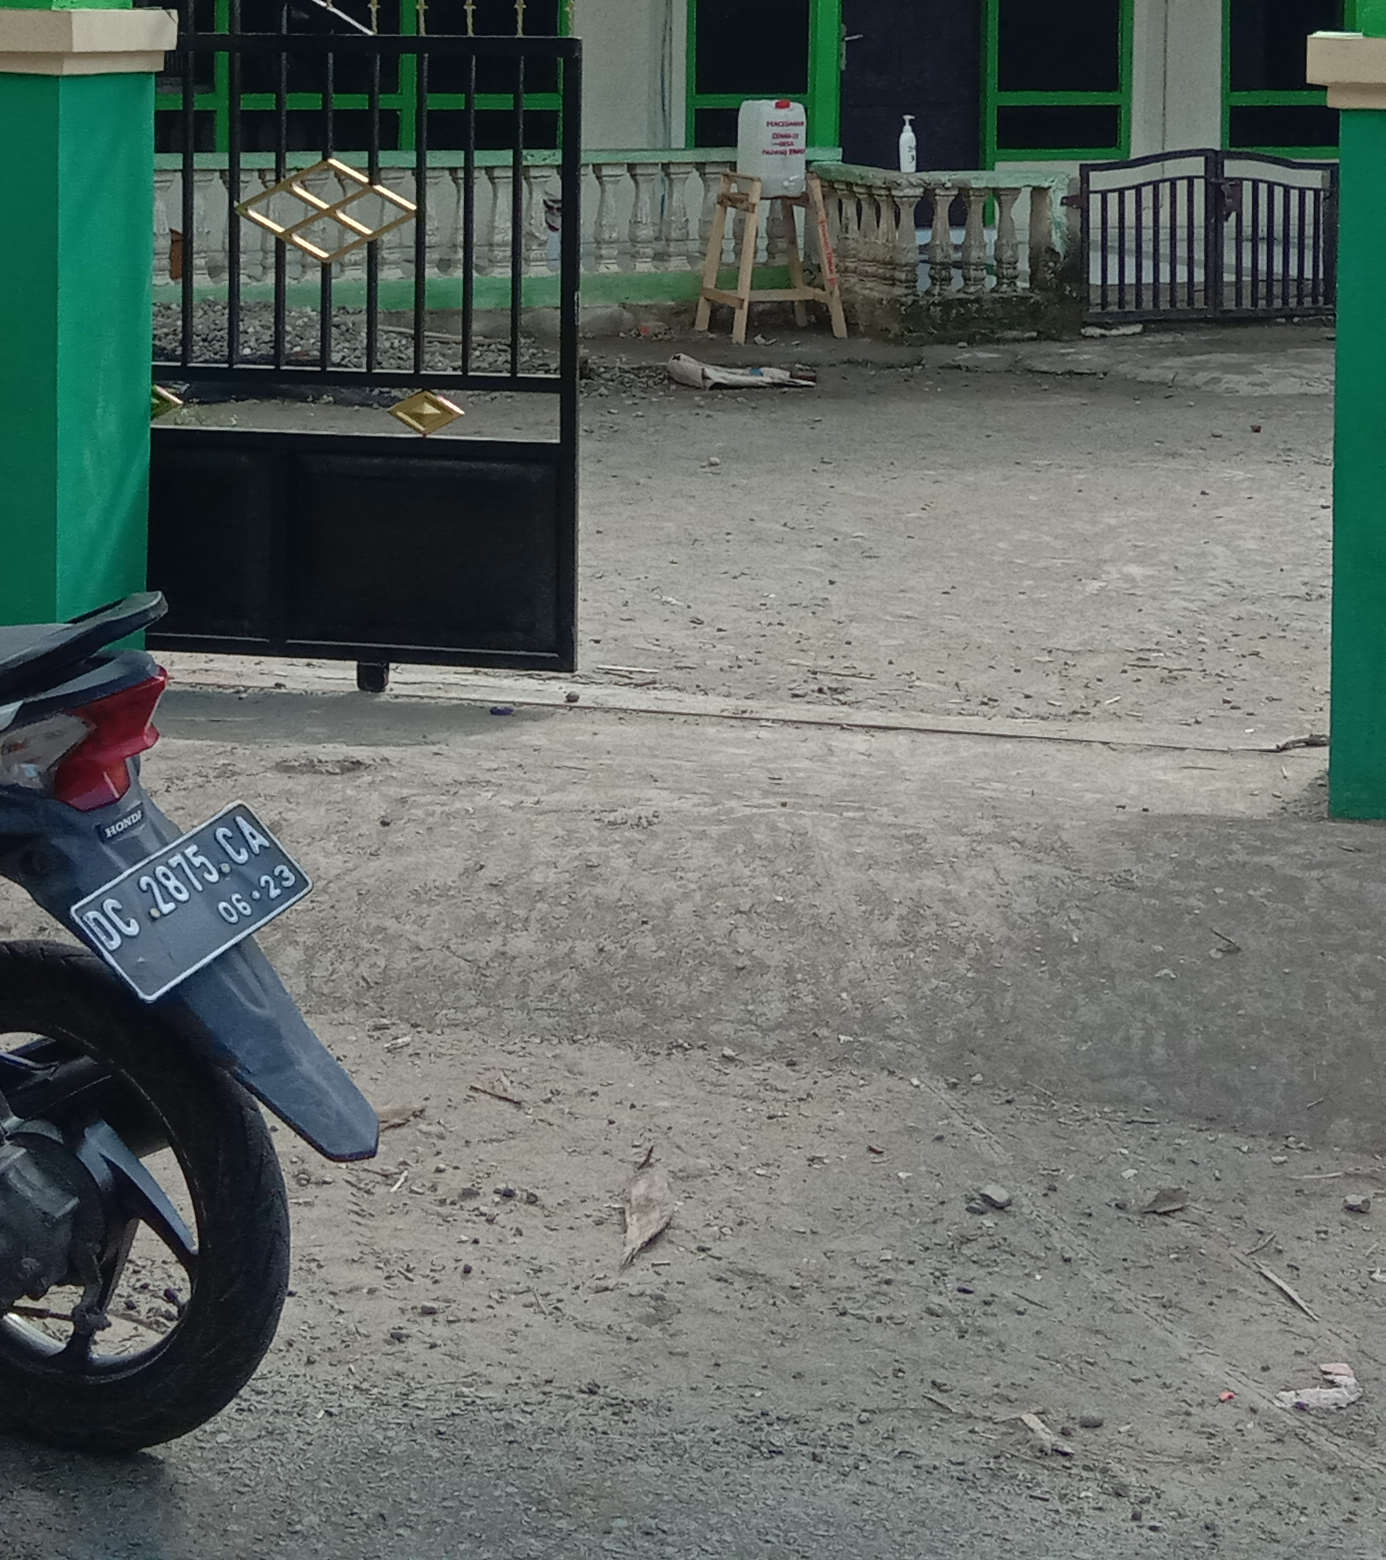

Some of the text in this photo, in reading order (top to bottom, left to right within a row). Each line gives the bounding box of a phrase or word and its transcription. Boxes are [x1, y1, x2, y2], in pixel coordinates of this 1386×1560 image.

[82, 815, 270, 951] DC 2875 CA
